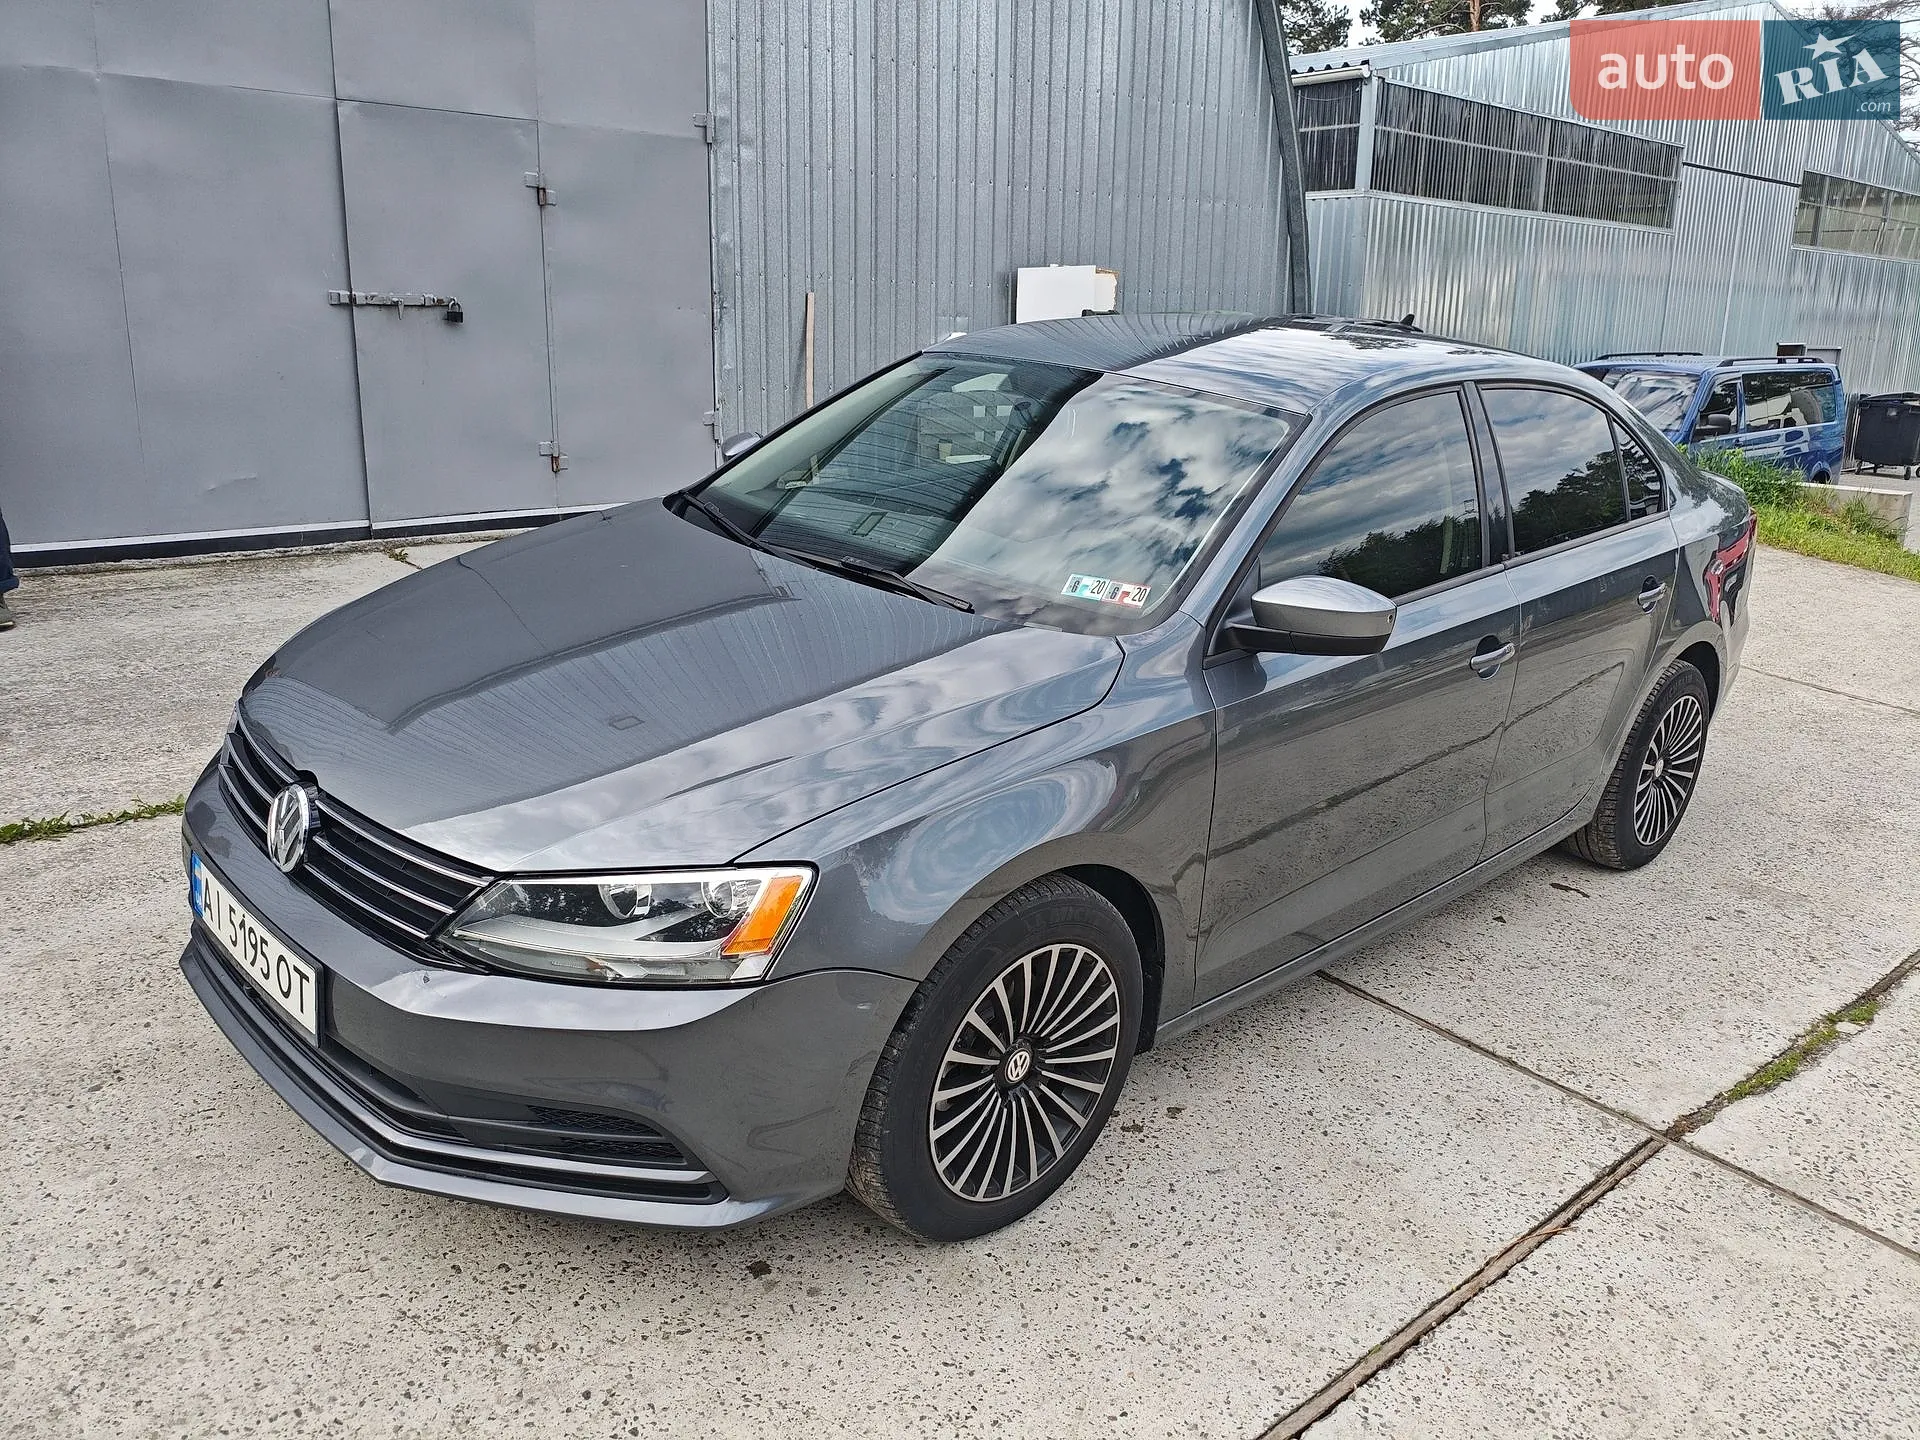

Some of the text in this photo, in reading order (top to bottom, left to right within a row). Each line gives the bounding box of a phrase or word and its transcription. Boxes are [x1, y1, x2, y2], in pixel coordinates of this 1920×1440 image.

[1090, 579, 1106, 595] 20
[1131, 587, 1147, 602] 20
[203, 877, 310, 1015] AI 5195 OT
